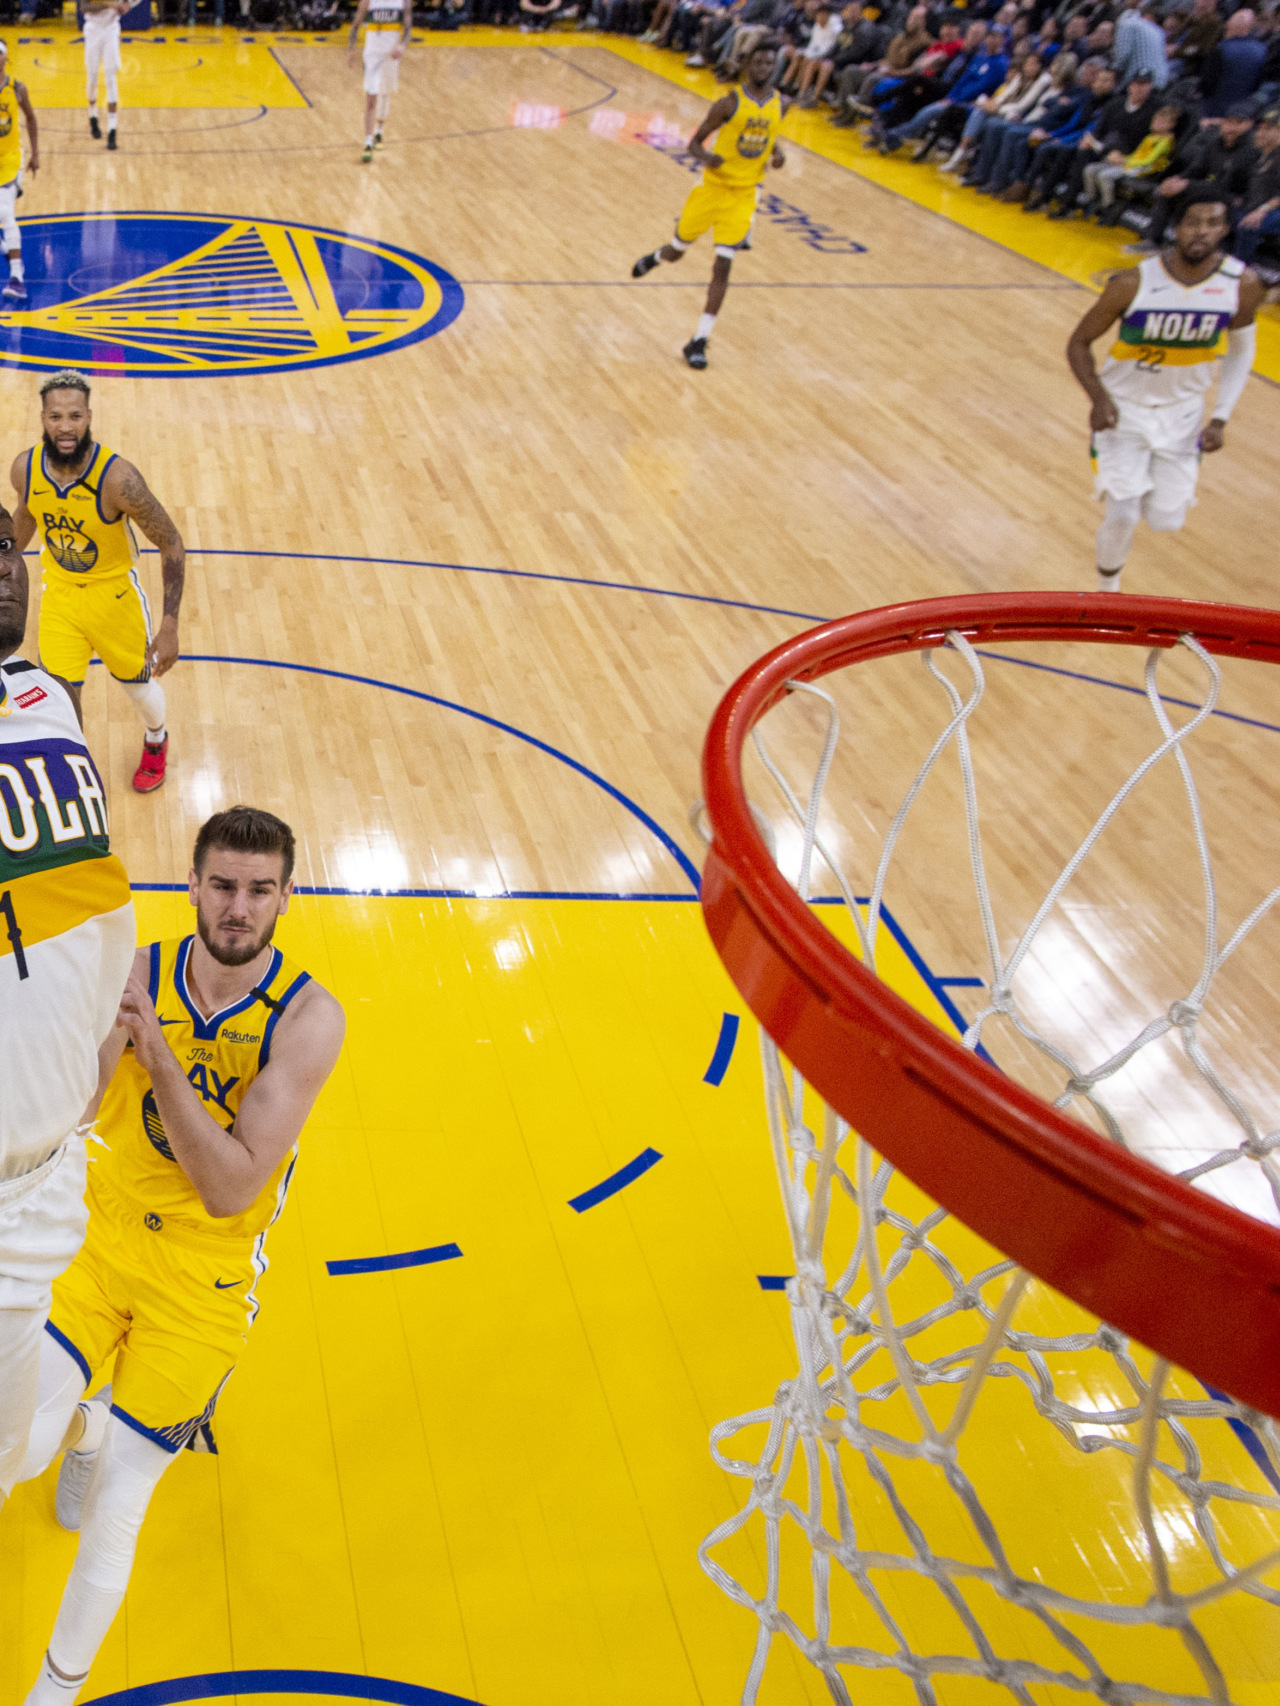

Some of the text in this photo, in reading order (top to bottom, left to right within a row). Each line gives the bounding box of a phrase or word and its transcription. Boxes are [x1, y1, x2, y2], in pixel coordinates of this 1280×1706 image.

[1143, 312, 1220, 341] NOLA
[1135, 347, 1167, 373] 22
[43, 512, 85, 533] BAY
[60, 533, 77, 551] 12
[221, 1028, 260, 1043] Rakuten
[186, 1048, 213, 1062] The
[188, 1062, 240, 1107] AY
